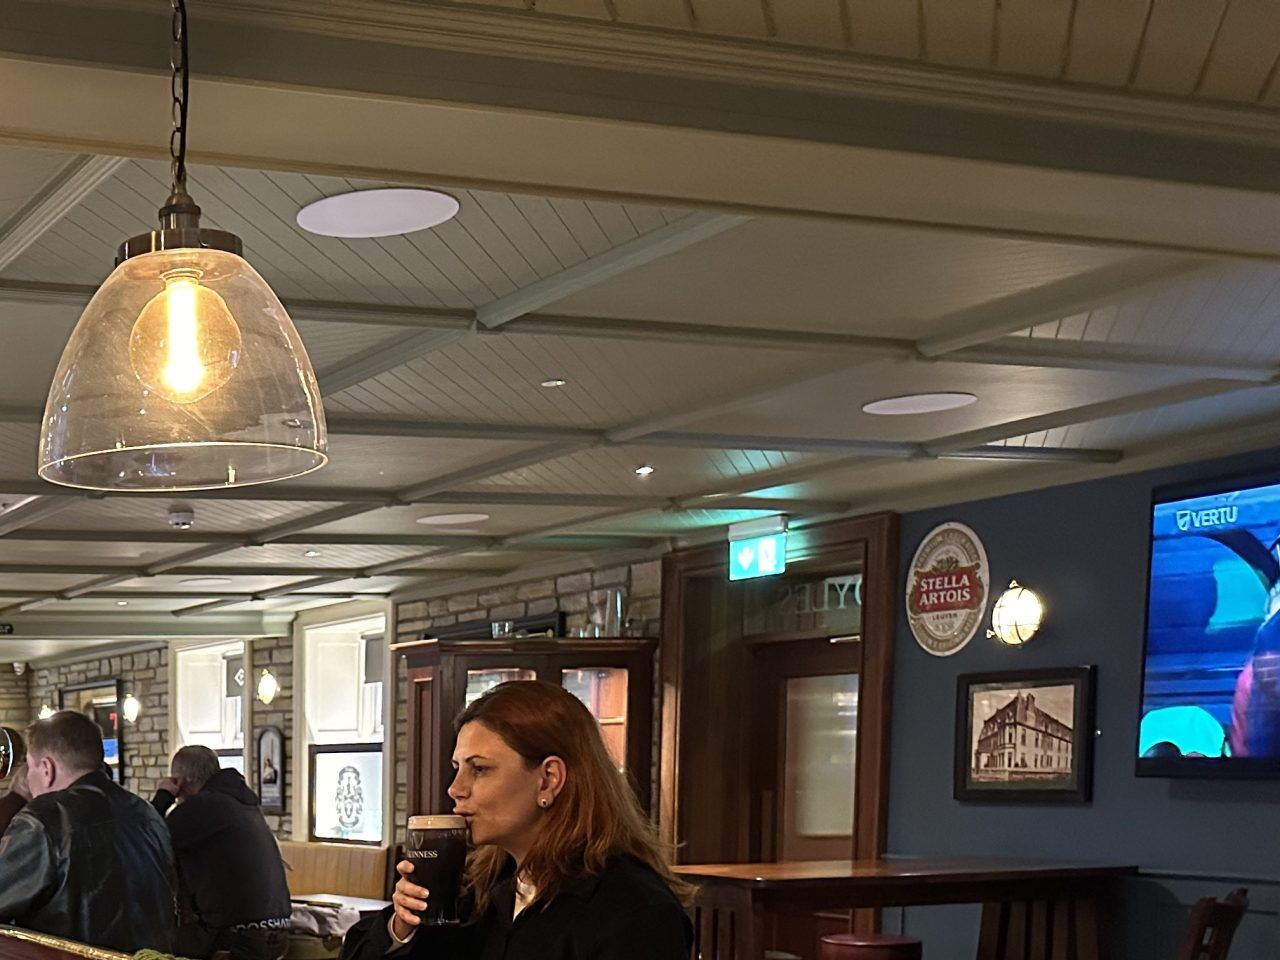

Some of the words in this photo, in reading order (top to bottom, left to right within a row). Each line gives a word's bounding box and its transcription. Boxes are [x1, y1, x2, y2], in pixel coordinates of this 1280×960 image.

[1191, 506, 1239, 527] VERTU
[920, 574, 970, 592] STELLA
[920, 589, 971, 606] ARTOIS
[406, 850, 438, 859] UINNESS
